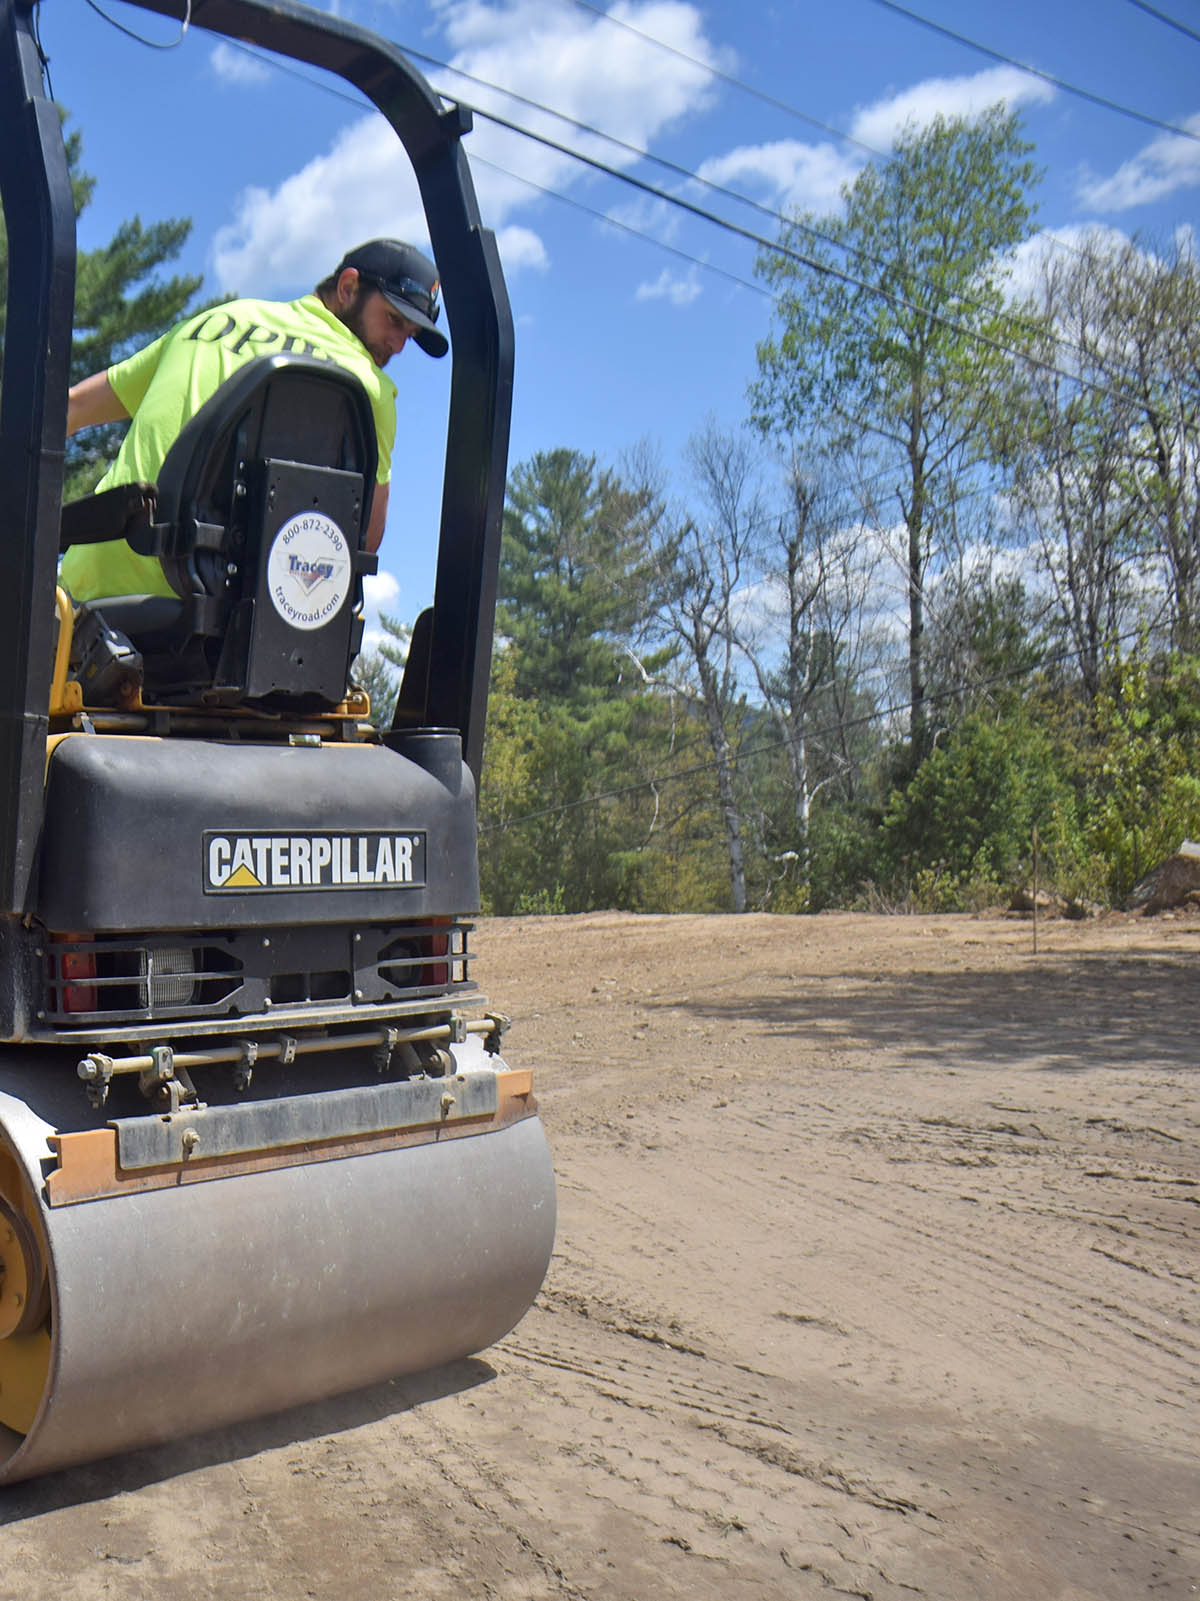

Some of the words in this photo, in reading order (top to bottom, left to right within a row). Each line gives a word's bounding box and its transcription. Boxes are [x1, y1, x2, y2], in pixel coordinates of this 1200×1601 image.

[282, 518, 343, 552] 800-872-2390
[288, 554, 334, 579] Tracey
[275, 586, 340, 622] traceyroad.com
[208, 836, 414, 886] CATERPILLAR
